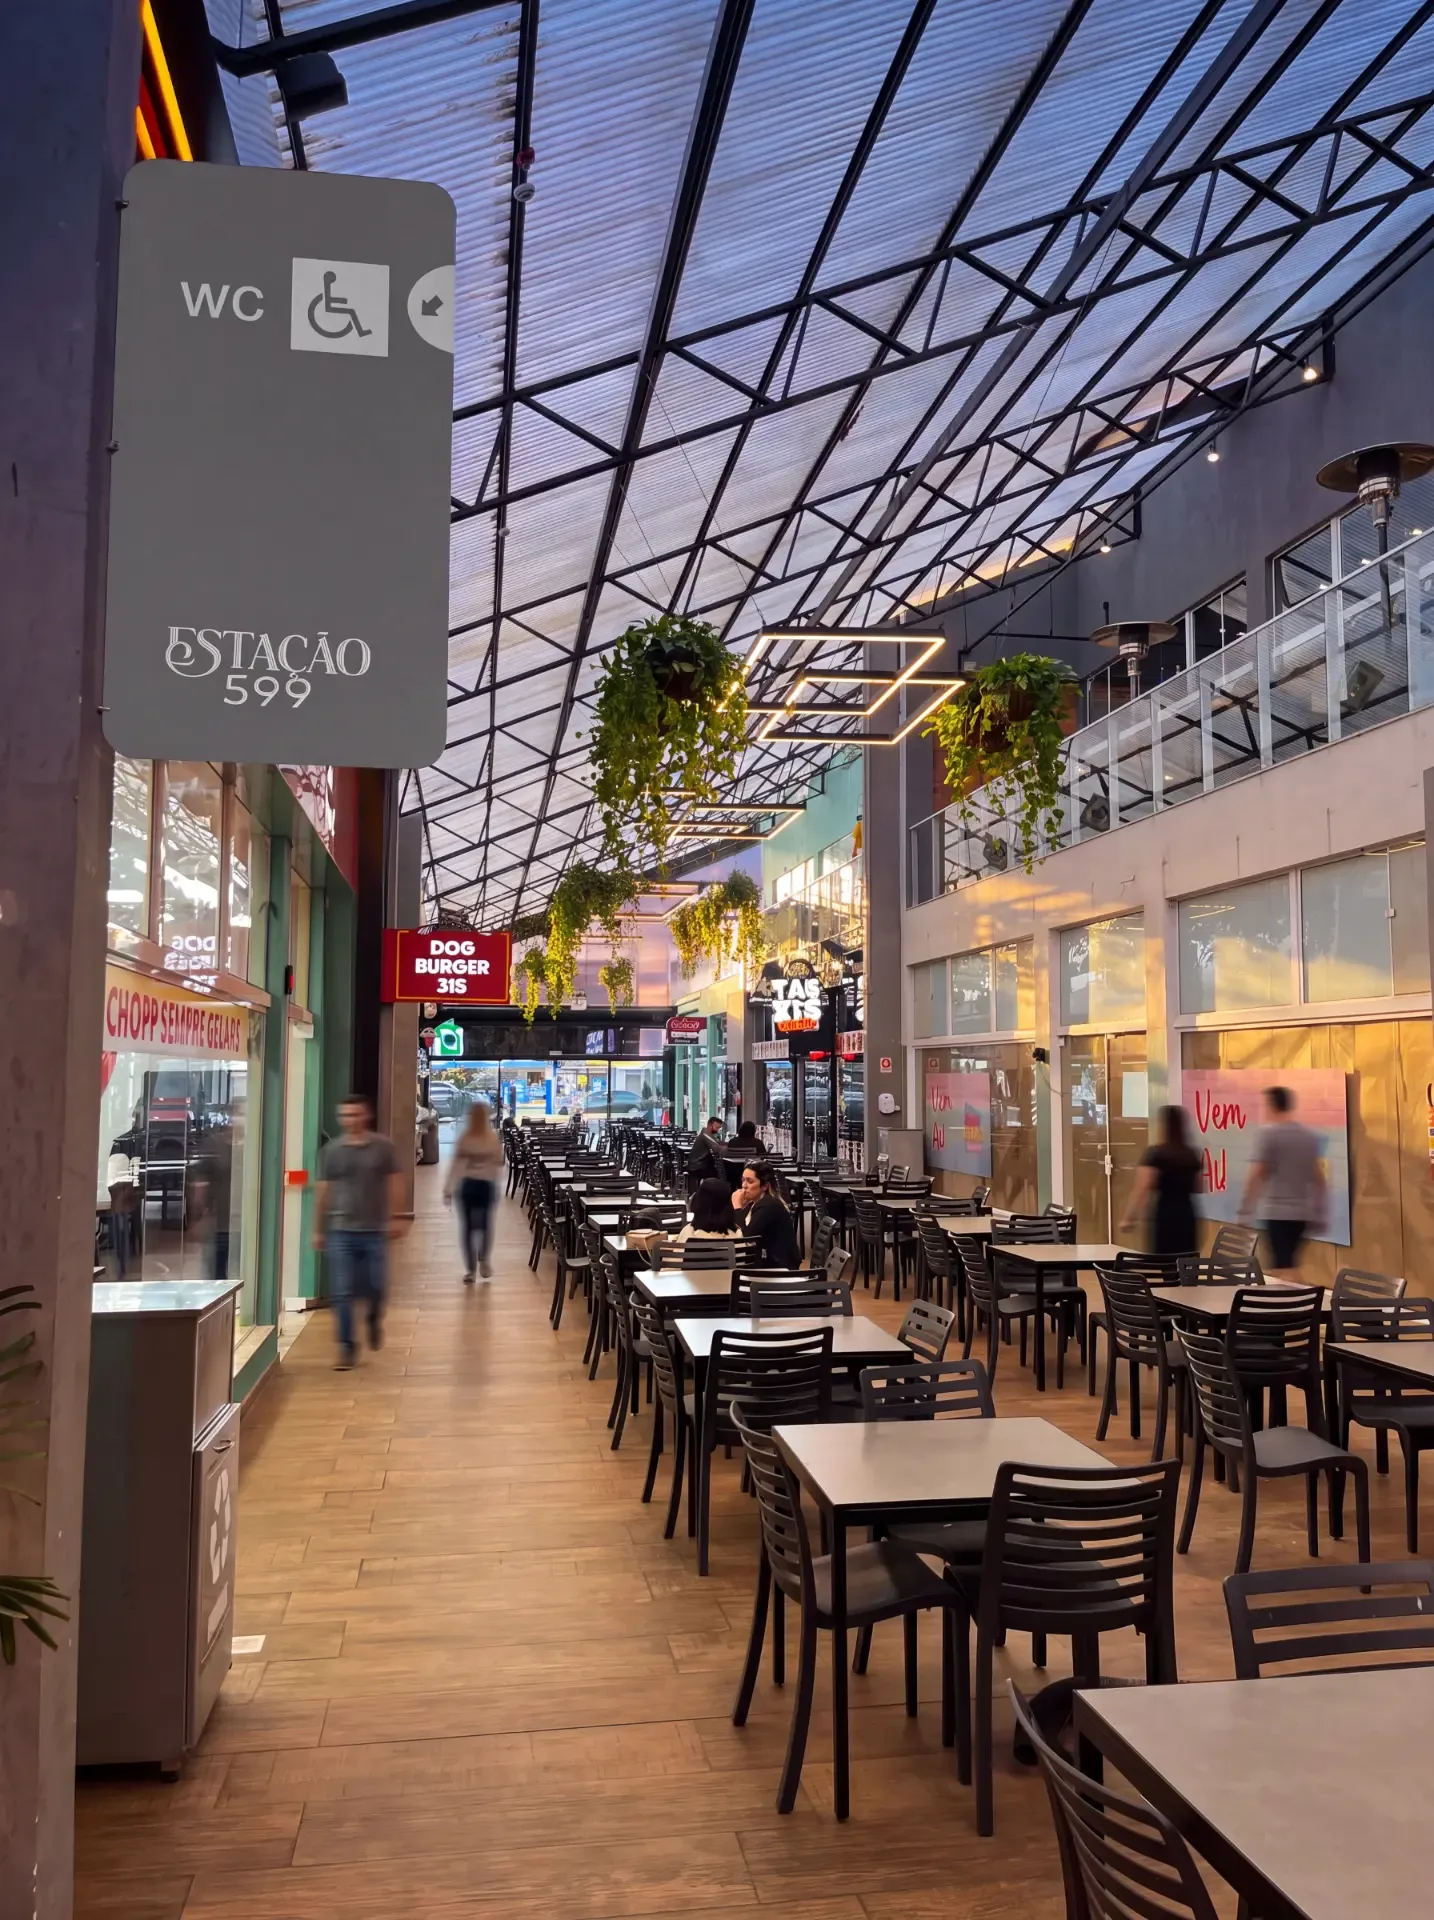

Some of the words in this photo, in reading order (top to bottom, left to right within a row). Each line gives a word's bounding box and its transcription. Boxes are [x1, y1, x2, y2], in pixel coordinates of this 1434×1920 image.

[180, 281, 264, 322] WC
[165, 625, 371, 681] ESTAÇÃO
[223, 674, 311, 709] 599
[415, 958, 490, 975] BURGER
[430, 939, 476, 956] DOG
[106, 986, 159, 1042] CHOPP
[160, 1000, 206, 1047] SEMPRE
[1195, 1088, 1247, 1134] Vem
